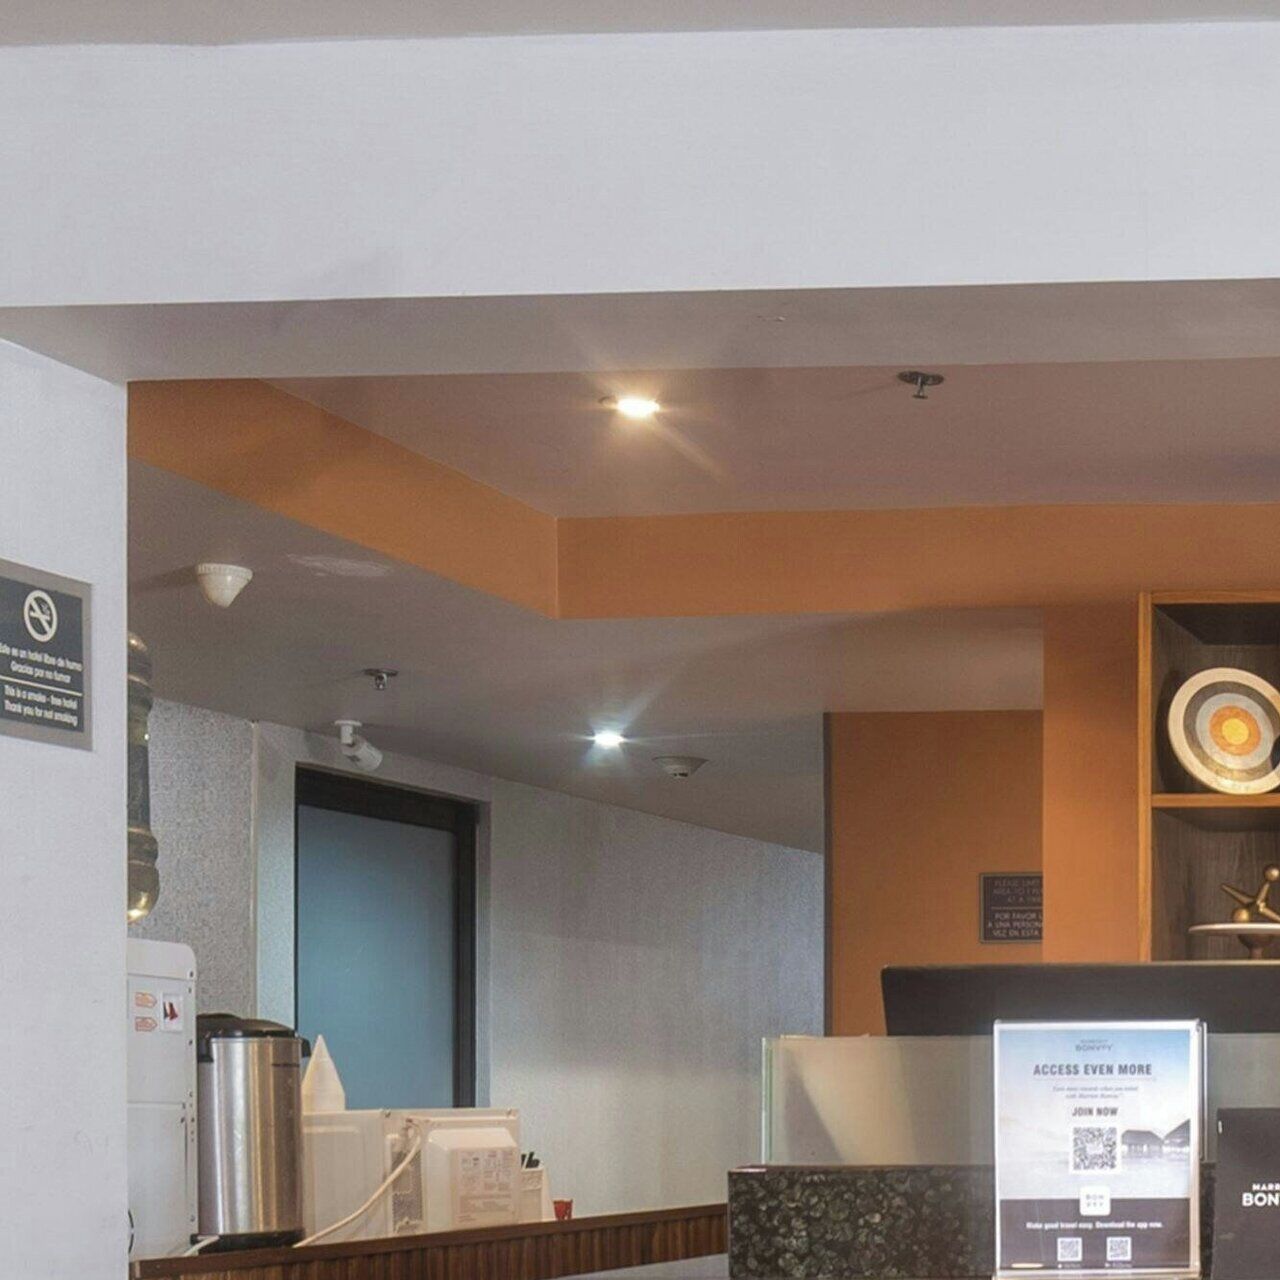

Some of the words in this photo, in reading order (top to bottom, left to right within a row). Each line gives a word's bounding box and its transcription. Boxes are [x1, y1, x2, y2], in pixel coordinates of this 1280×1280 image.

[1033, 1064, 1080, 1076] ACCESS
[1083, 1064, 1114, 1075] EVEN
[1118, 1063, 1152, 1075] MORE
[1072, 1107, 1094, 1117] JOIN
[1096, 1107, 1118, 1117] NOW
